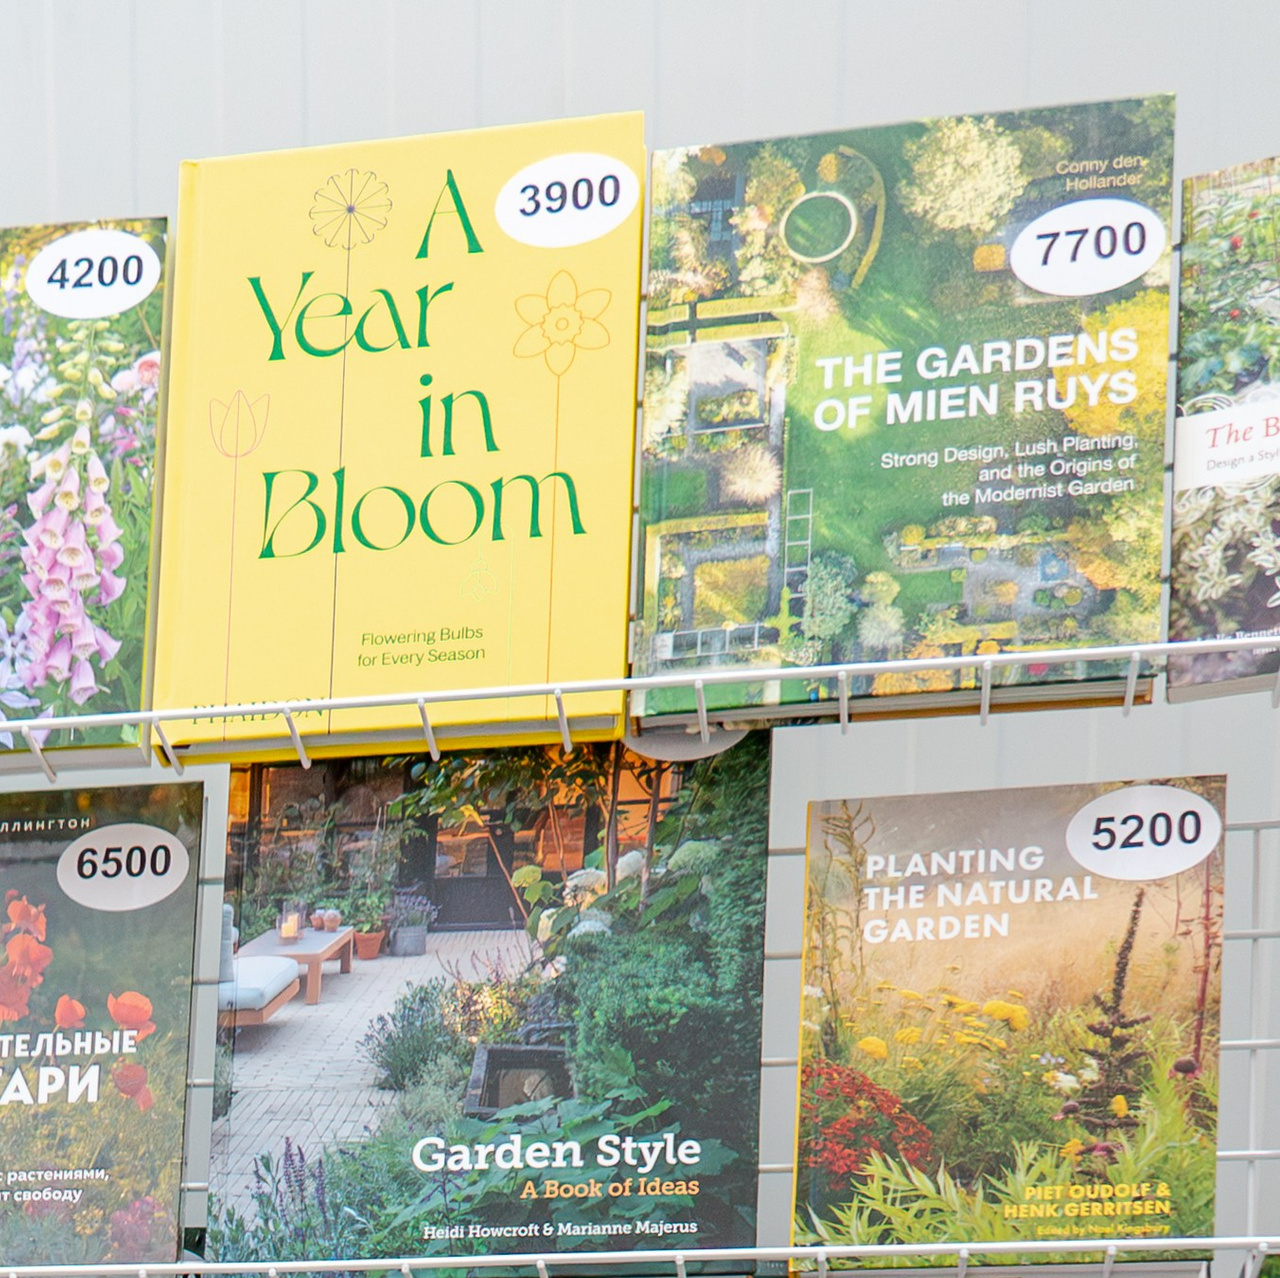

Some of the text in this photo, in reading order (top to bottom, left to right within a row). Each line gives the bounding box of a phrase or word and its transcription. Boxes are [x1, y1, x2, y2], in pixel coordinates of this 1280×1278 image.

[415, 169, 484, 260] A
[519, 174, 620, 216] 3900
[1036, 222, 1147, 266] 7700
[47, 255, 144, 290] 4200
[247, 270, 454, 362] Year
[816, 328, 1138, 390] THE GARDENS
[419, 374, 500, 458] in
[813, 372, 1138, 432] OF MIEN RUYS
[258, 466, 587, 559] Bloom
[358, 647, 485, 667] for Every Season
[361, 625, 483, 647] Flowering Bulbs
[1092, 810, 1201, 851] 5200
[77, 844, 171, 880] 6500
[865, 846, 1045, 879] PLANTING
[863, 877, 1098, 910] THE NATURAL
[863, 914, 1010, 944] GARDEN
[412, 1132, 701, 1174] Garden Style
